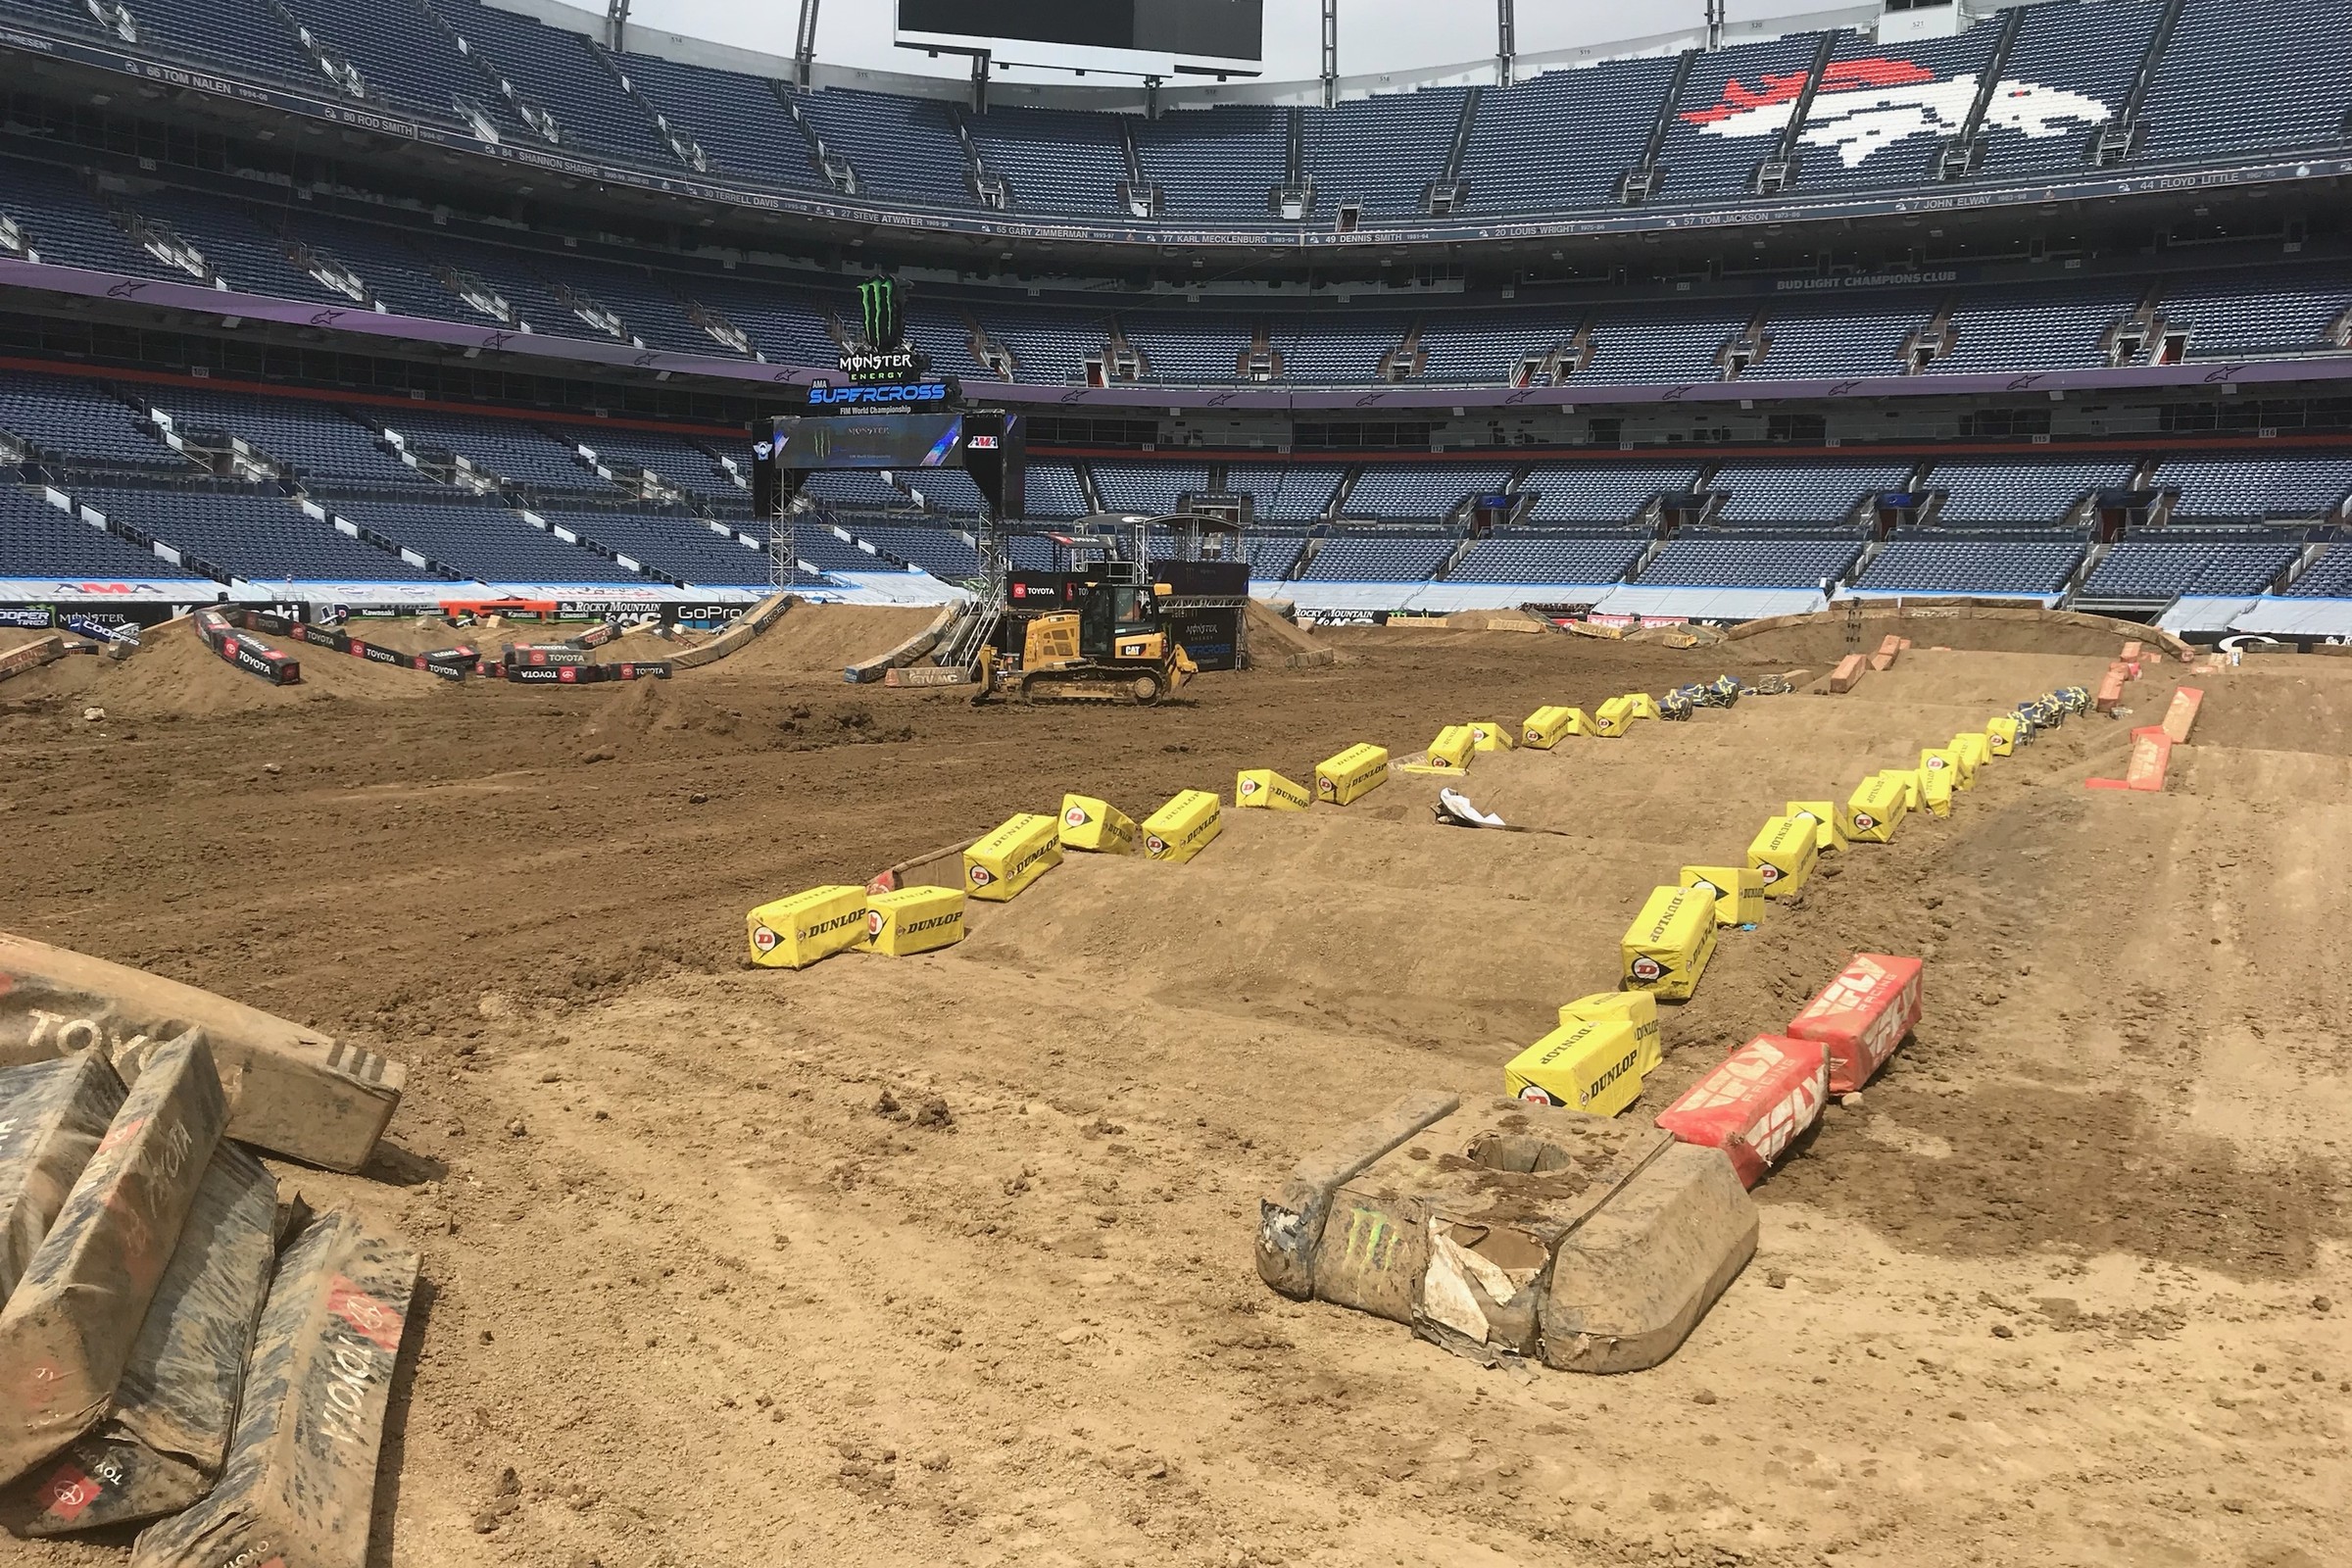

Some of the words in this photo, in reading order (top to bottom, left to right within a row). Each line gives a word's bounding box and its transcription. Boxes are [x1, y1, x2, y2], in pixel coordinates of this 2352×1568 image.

[147, 64, 161, 77] 66
[164, 68, 189, 85] TOM
[192, 76, 231, 95] NALEN
[343, 111, 356, 123] 80
[357, 114, 380, 129] ROD
[381, 120, 413, 137] SMITH
[502, 147, 513, 158] 84
[518, 151, 564, 171] SHANNON
[564, 160, 599, 177] SHARPE
[2140, 180, 2154, 190] 44
[2160, 175, 2195, 189] FLOYD
[2202, 172, 2239, 185] LITTLE
[704, 188, 714, 198] 30
[715, 190, 752, 206] TERRELL
[754, 196, 779, 209] DAVIS
[1914, 200, 1920, 210] 7
[1923, 198, 1953, 210] JOHN
[1957, 195, 1991, 207] ELWAY
[841, 209, 852, 219] 27
[854, 211, 880, 222] STEVE
[881, 214, 923, 226] ATWATER
[1684, 217, 1695, 226] 57
[1699, 215, 1721, 225] TOM
[1723, 212, 1769, 223] JACKSON
[997, 225, 1007, 234] 65
[1008, 225, 1032, 236] GARY
[1035, 227, 1089, 239] ZIMMERMAN
[1162, 234, 1173, 243] 77
[1177, 234, 1200, 243] KARL
[1201, 234, 1267, 244] MECKLENBURG
[1325, 234, 1336, 243] 49
[1340, 233, 1371, 243] DENNIS
[1374, 231, 1402, 241] SMITH
[1494, 228, 1506, 237] 20
[1510, 226, 1537, 236] LOUIS
[1540, 223, 1575, 234] WRIGHT
[1777, 280, 1802, 290] BUD
[1805, 278, 1840, 289] LIGHT
[1844, 273, 1921, 287] CHAMPIONS
[1923, 270, 1956, 282] CLUB
[840, 353, 913, 371] MONSTER
[812, 379, 827, 389] AMA
[851, 371, 905, 381] ENERGY
[808, 383, 947, 404] SUPERCROSS
[869, 404, 911, 415] Championship
[969, 436, 998, 448] AMA
[53, 583, 165, 594] AMA
[576, 601, 605, 612] ROCKY
[610, 601, 662, 612] MOUNTAIN
[678, 606, 743, 619] GoPro
[1294, 608, 1324, 618] ROCKY
[1324, 608, 1374, 618] MOUNTAIN
[0, 612, 50, 620] OOPER
[59, 612, 126, 625] MONSTER
[307, 630, 334, 646] TOYOTA
[367, 648, 395, 663] TOYOTA
[549, 654, 585, 662] TOYOTA
[1125, 646, 1140, 656] CAT
[239, 650, 271, 675] TOYOTA
[429, 663, 459, 676] TOYOTA
[636, 667, 664, 676] TOYOTA
[1351, 762, 1388, 786] DUNLOP
[1164, 792, 1200, 821] DUNLOP
[1275, 788, 1309, 809] DUNLOP
[993, 813, 1036, 848] DUNLOP
[1107, 822, 1133, 844] DUNLOP
[1187, 809, 1221, 844] DUNLOP
[1770, 820, 1793, 851] DUNLOP
[1016, 835, 1060, 874] DUNLOP
[808, 907, 867, 938] DUNLOP
[908, 911, 963, 935] DUNLOP
[1649, 897, 1685, 943] DUNLOP
[1857, 972, 1897, 1011] RACING
[1636, 1017, 1659, 1042] DUNLOP
[1540, 1027, 1592, 1065] DUNLOP
[1591, 1049, 1638, 1101] DUNLOP
[1740, 1057, 1796, 1102] RACING
[320, 1334, 379, 1446] TOYOTA
